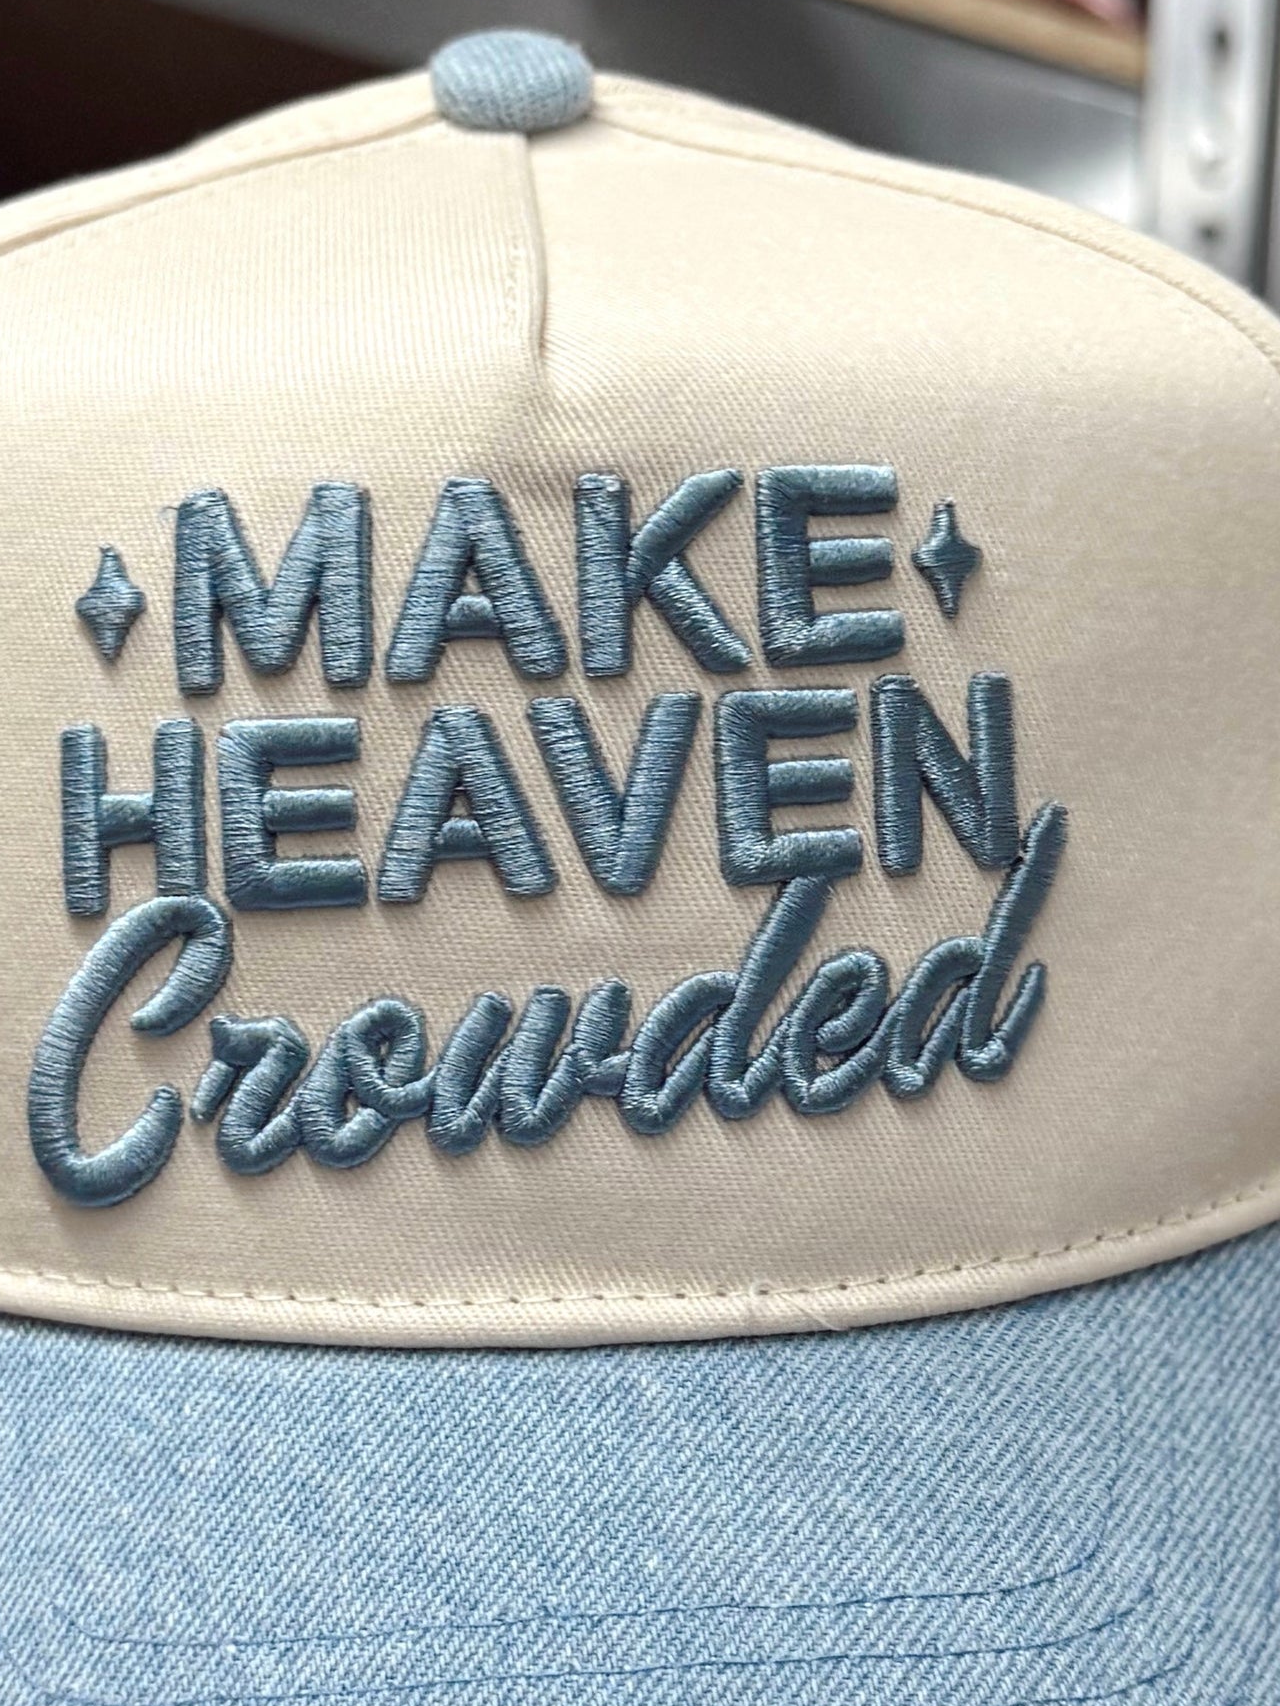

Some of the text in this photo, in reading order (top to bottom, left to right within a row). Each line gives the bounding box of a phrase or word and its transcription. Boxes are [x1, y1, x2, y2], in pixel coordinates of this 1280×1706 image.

[173, 463, 907, 695] MAKE
[59, 671, 1020, 917] HEAVEN
[28, 801, 1067, 1208] Crowded
